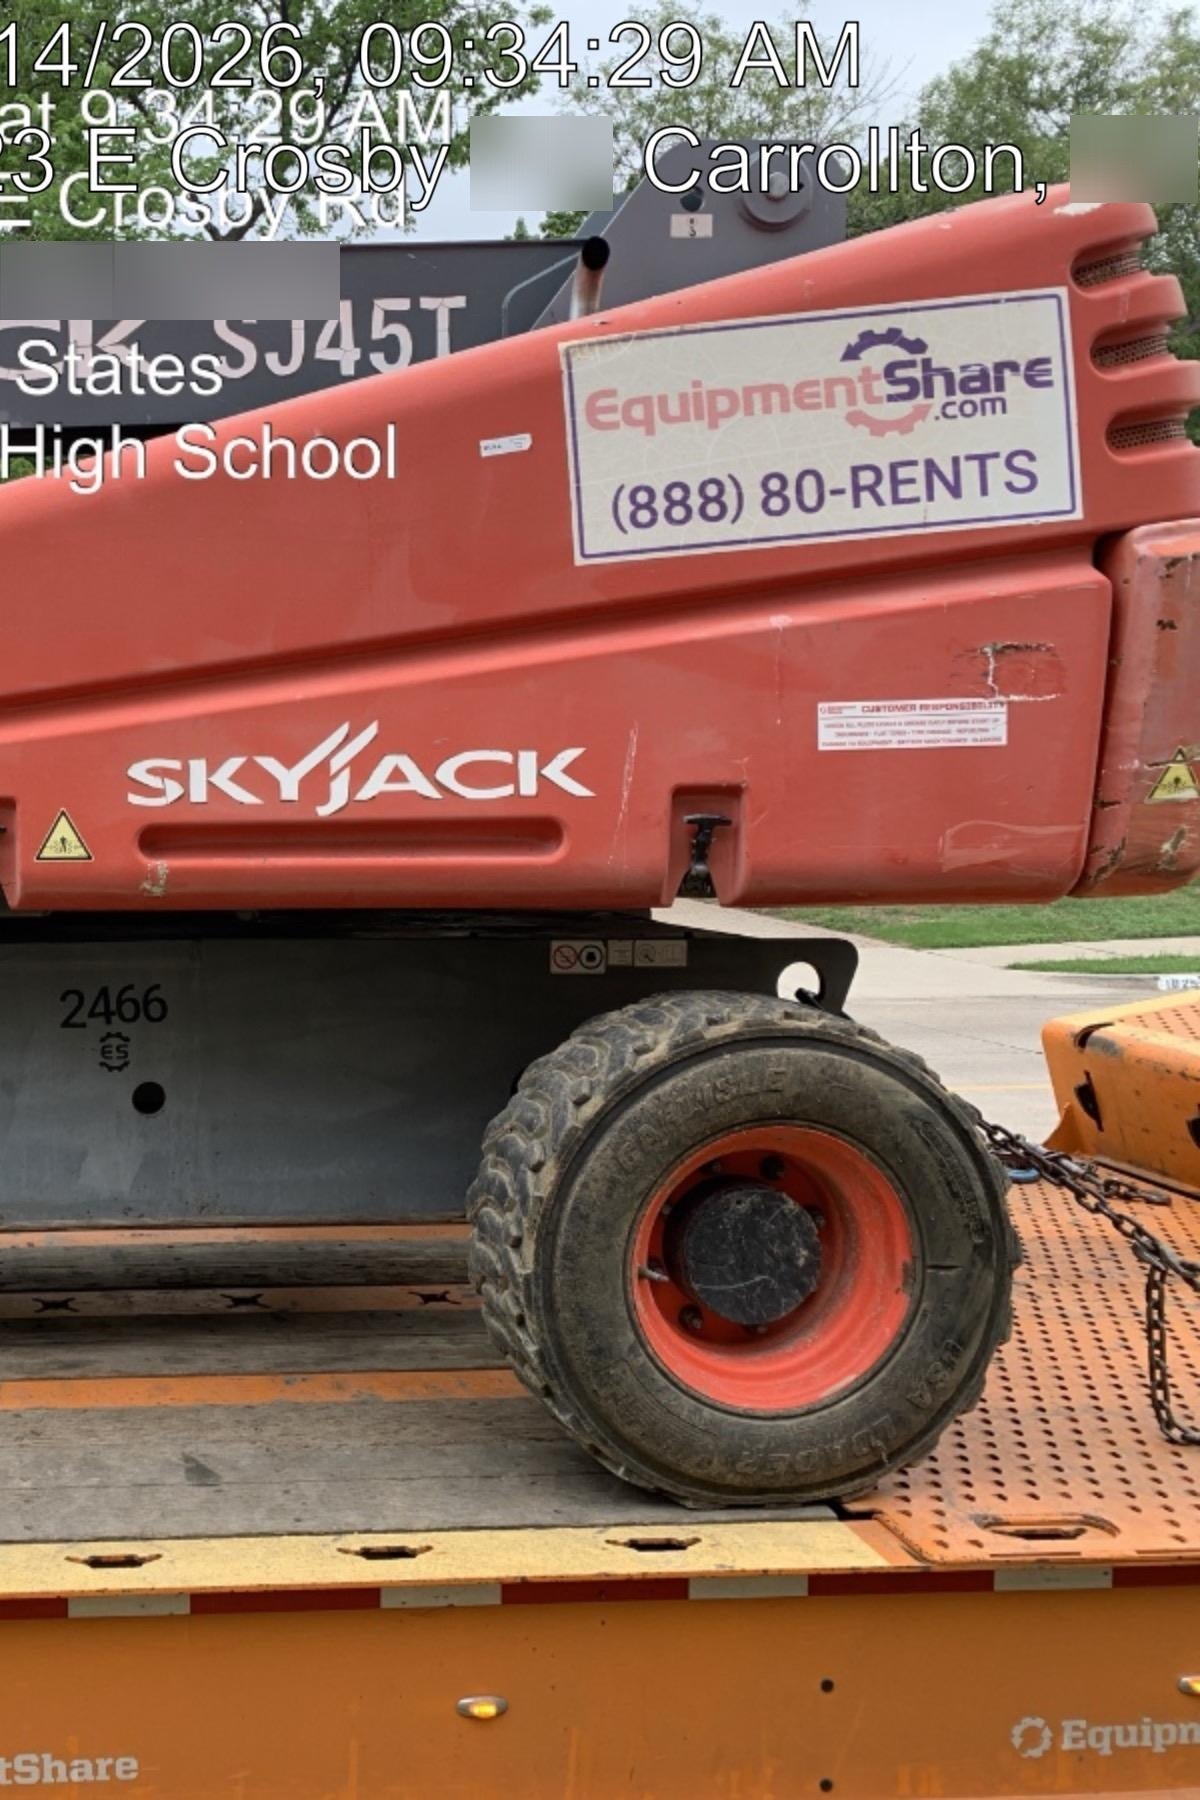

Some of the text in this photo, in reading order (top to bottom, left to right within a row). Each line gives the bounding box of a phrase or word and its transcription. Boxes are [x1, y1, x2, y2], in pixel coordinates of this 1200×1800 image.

[213, 295, 467, 379] SJ45T
[584, 356, 1055, 437] EquipmentShare
[933, 395, 1008, 422] .com
[612, 449, 1039, 535] (888) 80-RENTS
[127, 720, 597, 816] SKYJACK
[59, 984, 168, 1029] 2466
[101, 1044, 129, 1060] ES
